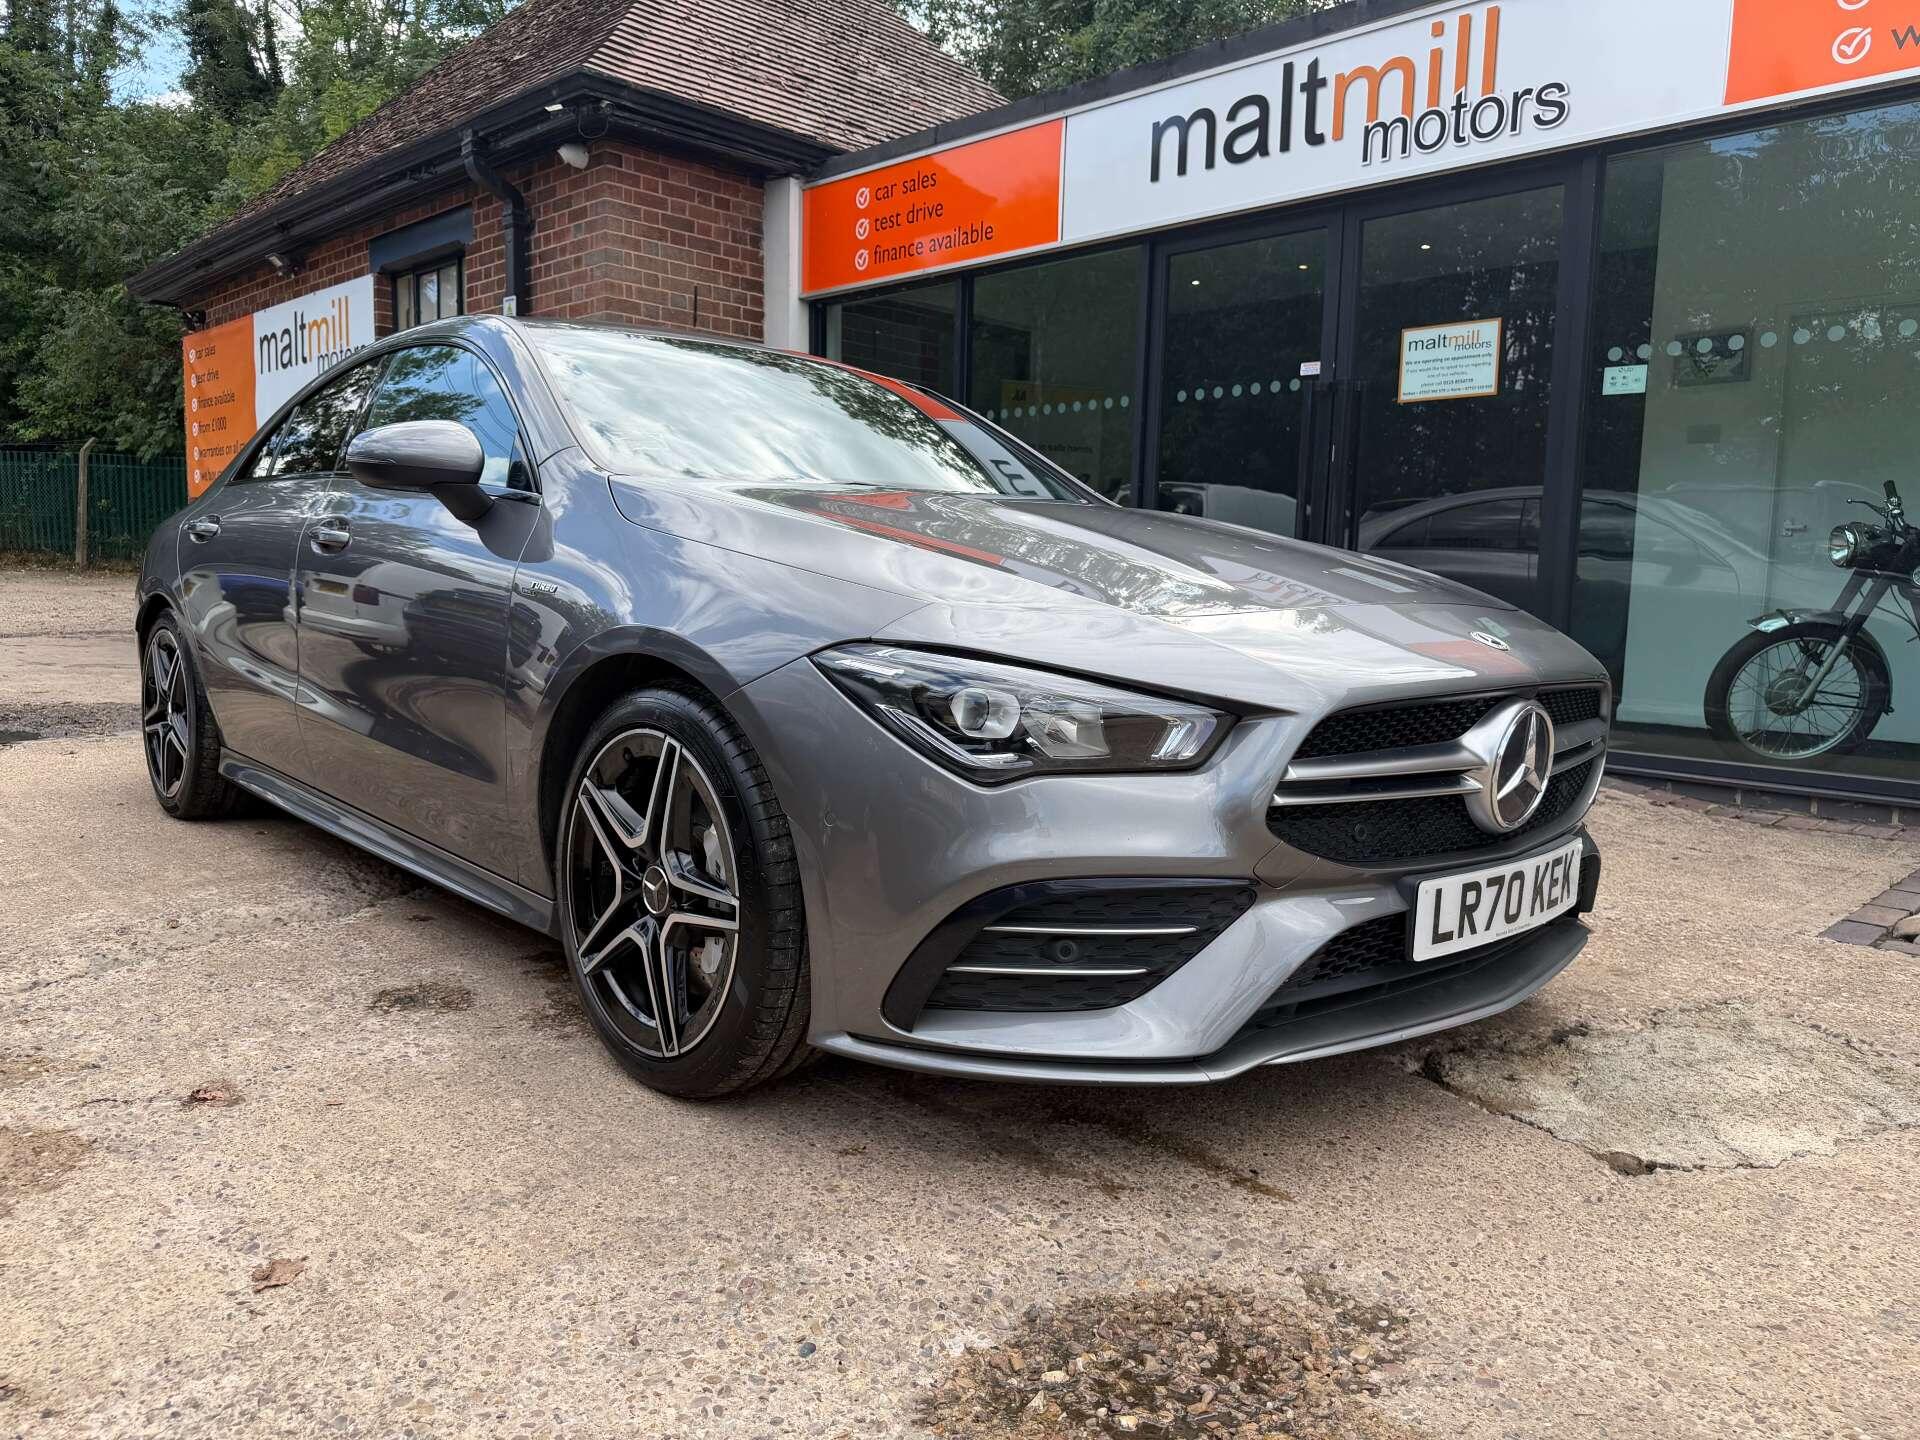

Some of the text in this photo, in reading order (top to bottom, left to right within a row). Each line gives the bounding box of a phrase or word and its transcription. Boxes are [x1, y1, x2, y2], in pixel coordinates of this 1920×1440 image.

[1150, 6, 1500, 183] maltmill
[1361, 80, 1570, 165] motors
[874, 170, 938, 202] car sales
[874, 202, 944, 233] test drive
[873, 220, 994, 265] finance available
[205, 344, 216, 357] sales
[259, 296, 350, 375] maltmill
[1408, 329, 1480, 352] maltmill
[1454, 340, 1492, 352] motors
[317, 343, 366, 375] moto
[196, 368, 219, 385] test drive
[198, 389, 236, 407] finance available
[198, 416, 227, 433] from £1000
[225, 446, 232, 455] on
[1431, 850, 1575, 945] LR70 KEK
